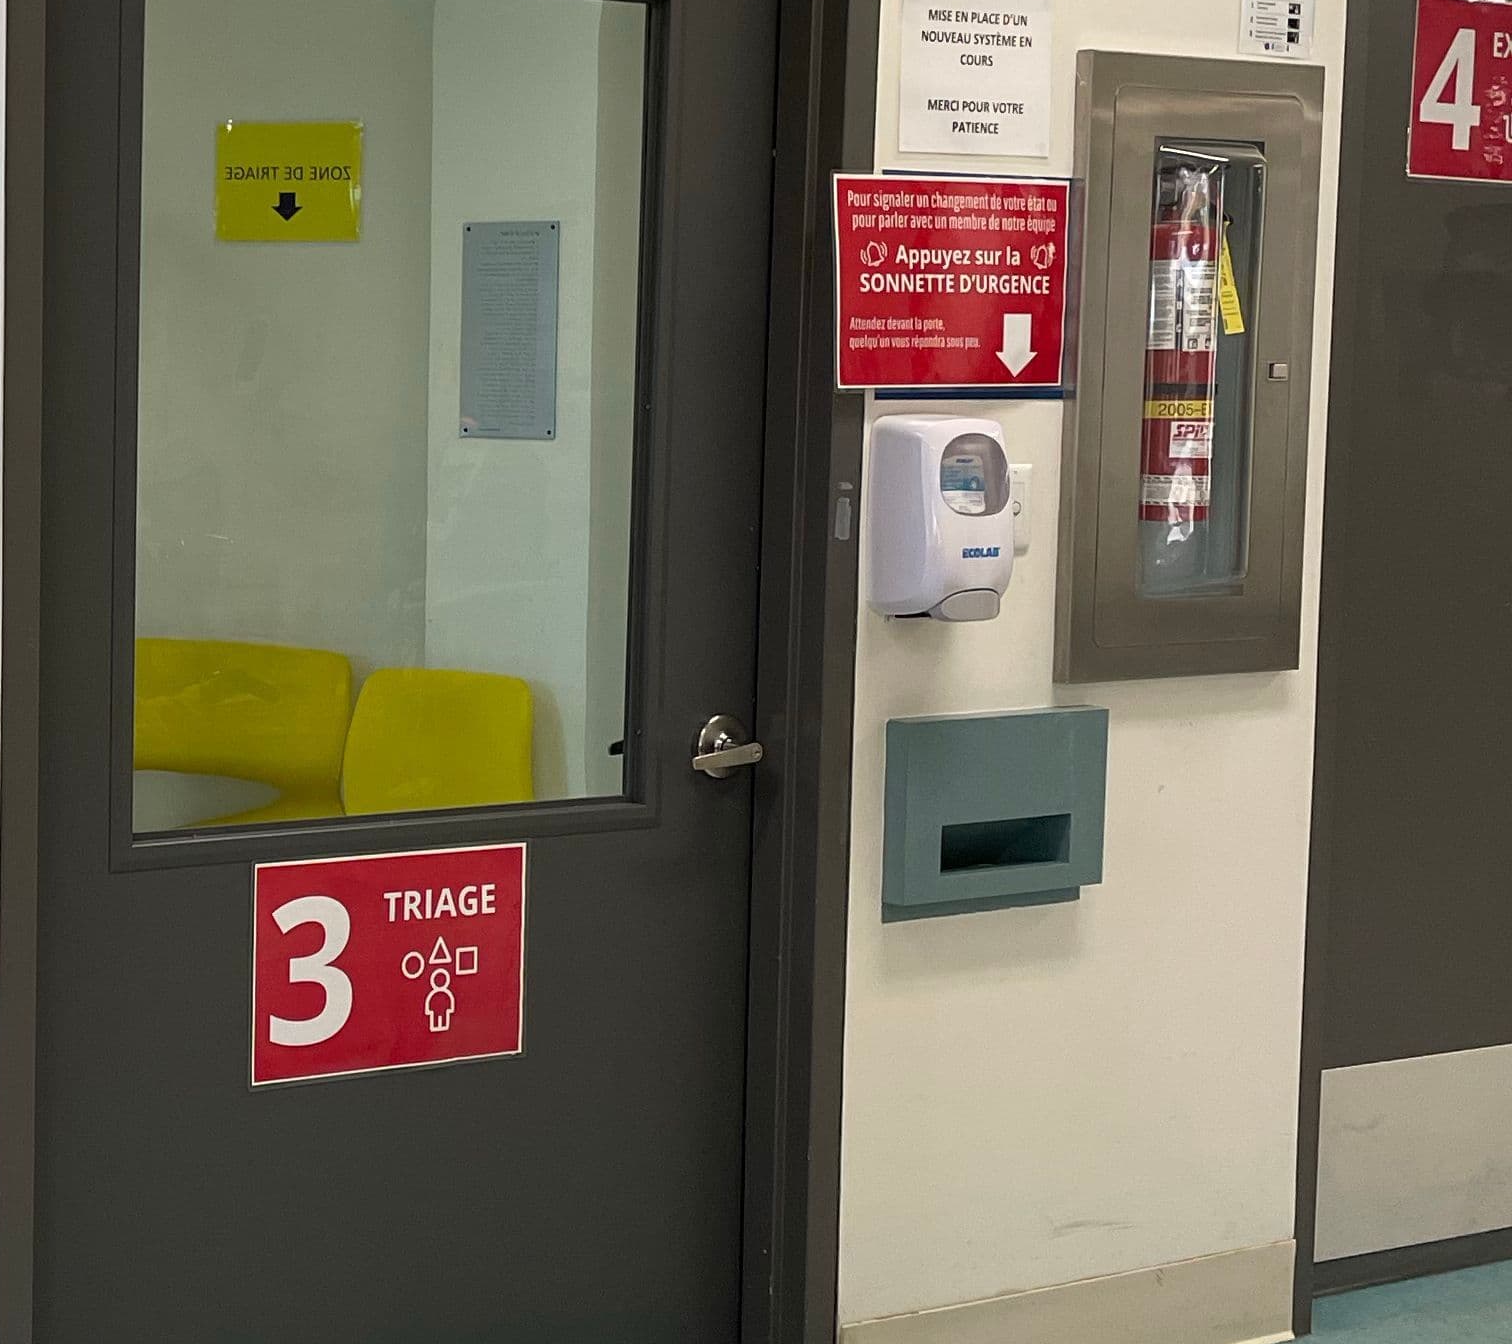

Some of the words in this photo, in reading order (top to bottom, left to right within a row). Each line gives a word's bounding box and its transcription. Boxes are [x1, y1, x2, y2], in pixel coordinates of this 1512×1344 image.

[928, 9, 952, 22] MISE
[955, 10, 969, 23] EN
[971, 12, 1000, 25] PLACE
[1003, 13, 1028, 26] D'UN
[921, 30, 971, 44] NOUVEAU
[973, 32, 1017, 47] SYSTÈME
[1019, 35, 1032, 48] EN
[960, 54, 993, 67] COURS
[1419, 28, 1481, 151] 4
[927, 99, 959, 112] MERCI
[962, 100, 989, 113] POUR
[992, 102, 1024, 115] VOTRE
[952, 121, 999, 134] PATIENCE
[847, 189, 871, 207] Pour
[873, 191, 914, 210] signaler
[916, 194, 929, 208] un
[931, 191, 989, 213] changement
[990, 193, 1002, 210] de
[1003, 194, 1026, 211] votre
[1028, 193, 1045, 212] état
[1046, 199, 1057, 212] ou
[852, 214, 876, 231] pour
[878, 211, 908, 231] parler
[910, 215, 933, 229] avec
[935, 216, 947, 229] un
[949, 213, 987, 230] membre
[988, 215, 1000, 231] de
[1001, 216, 1025, 231] notre
[1027, 215, 1056, 235] équipe
[895, 244, 972, 270] Appuyez
[974, 249, 1002, 266] sur
[1006, 246, 1021, 266] la
[859, 273, 955, 294] SONNETTE
[959, 274, 1050, 295] D'URGENCE
[849, 316, 885, 330] Attendez
[887, 316, 913, 330] devant
[915, 316, 922, 330] la
[891, 336, 910, 348] vous
[962, 546, 1000, 558] ECOLAB
[383, 883, 496, 922] TRIAGE
[269, 895, 354, 1047] 3
